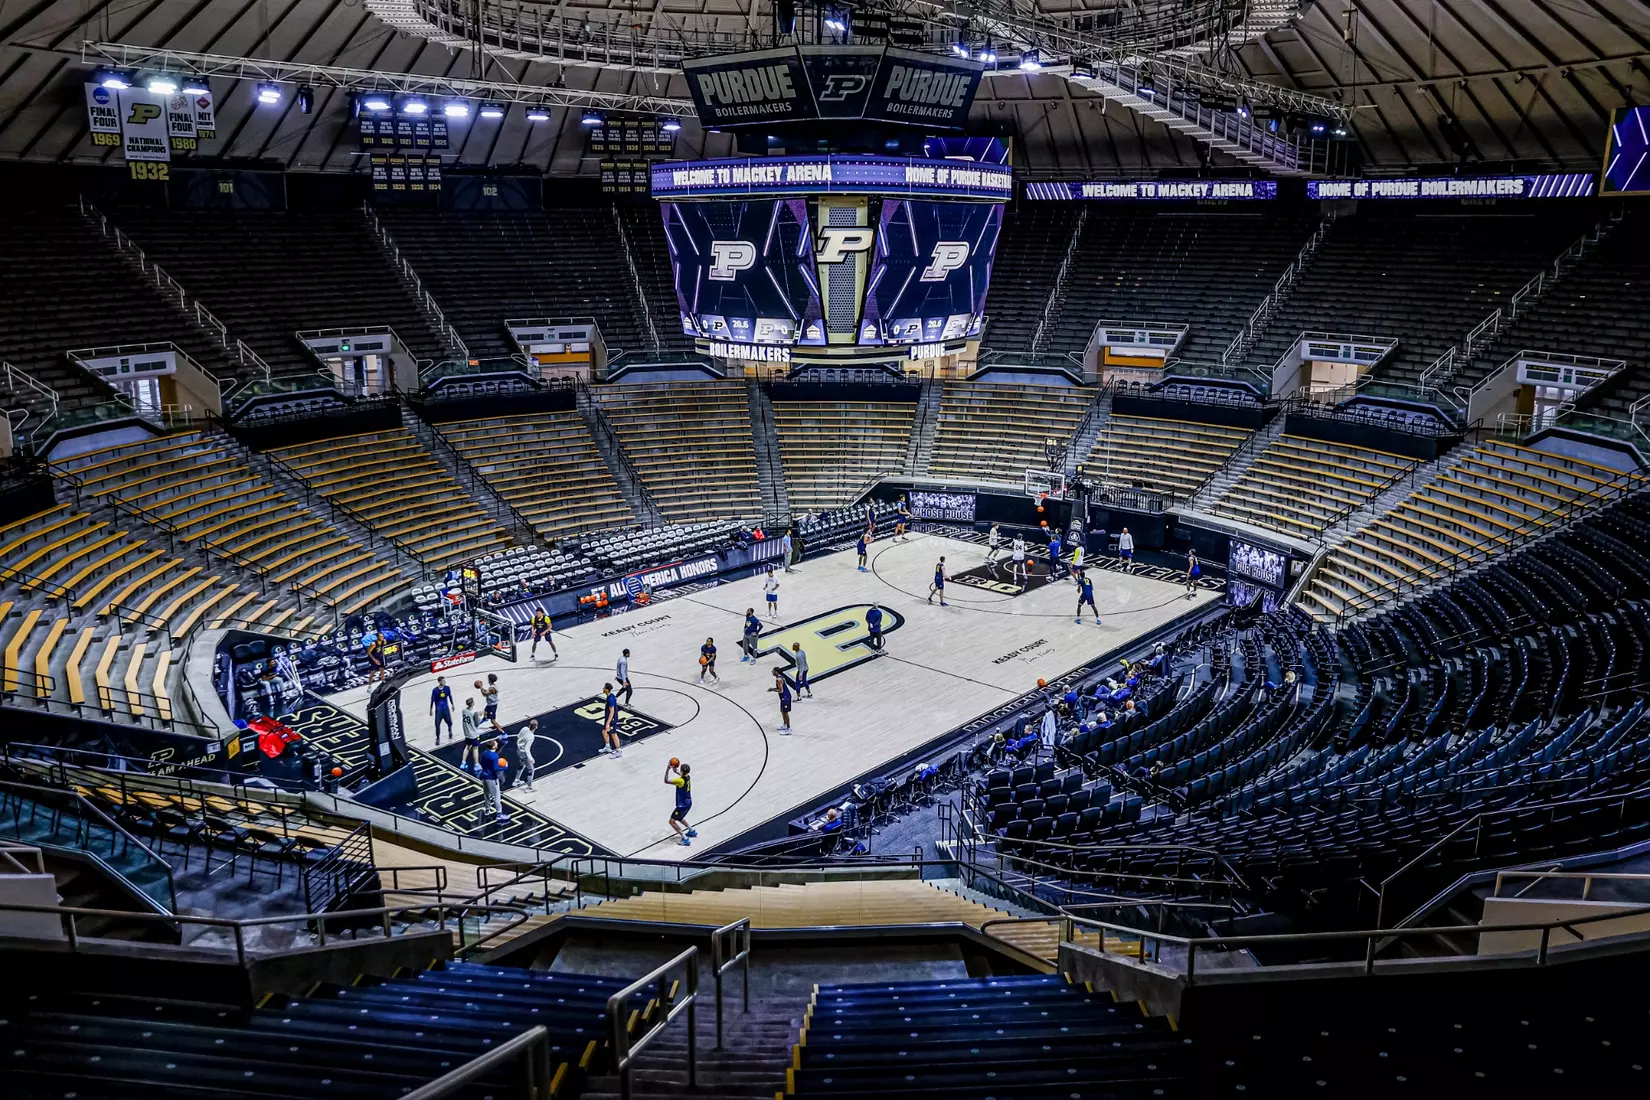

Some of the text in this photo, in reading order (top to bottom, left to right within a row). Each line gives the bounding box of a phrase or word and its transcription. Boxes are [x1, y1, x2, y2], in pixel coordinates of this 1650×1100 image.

[697, 64, 796, 106] PURDUE
[819, 74, 866, 101] P
[884, 65, 972, 107] PURDUE
[90, 106, 117, 118] FINAL
[169, 112, 194, 123] FINAL
[198, 111, 211, 121] NIT
[715, 101, 792, 118] BOILERMAKERS
[886, 102, 954, 119] BOILERMAKERS
[93, 117, 117, 128] FOUR
[172, 121, 193, 133] FOUR
[92, 133, 121, 146] 1969
[129, 136, 164, 146] NATIONAL
[198, 130, 215, 139] 1974
[127, 143, 167, 154] CHAMPIONS
[171, 138, 197, 150] 1980
[129, 162, 170, 181] 1932
[673, 164, 832, 186] WELCOME TO MACKEY ARENA
[905, 167, 935, 183] HOME
[937, 168, 949, 184] OF
[950, 169, 981, 186] PURDUE
[218, 183, 233, 193] 101
[483, 186, 498, 196] 102
[1082, 184, 1253, 198] WELCOME TO MACKEY ARENA
[1318, 179, 1523, 196] HOME OF PURDUE BOILERMAKERS
[816, 226, 875, 264] P
[708, 240, 756, 281] P
[919, 241, 970, 282] P
[732, 320, 749, 328] 20.6
[709, 342, 791, 363] BOILERMAKERS
[911, 343, 946, 360] PURDUE
[910, 507, 973, 520] WHOSE HOUSE
[679, 558, 717, 579] HONORS
[1236, 560, 1276, 585] OUR HOUSE
[600, 614, 672, 637] KEADY COURT
[991, 639, 1048, 664] KEADY COURT
[177, 752, 215, 768] AHEAD
